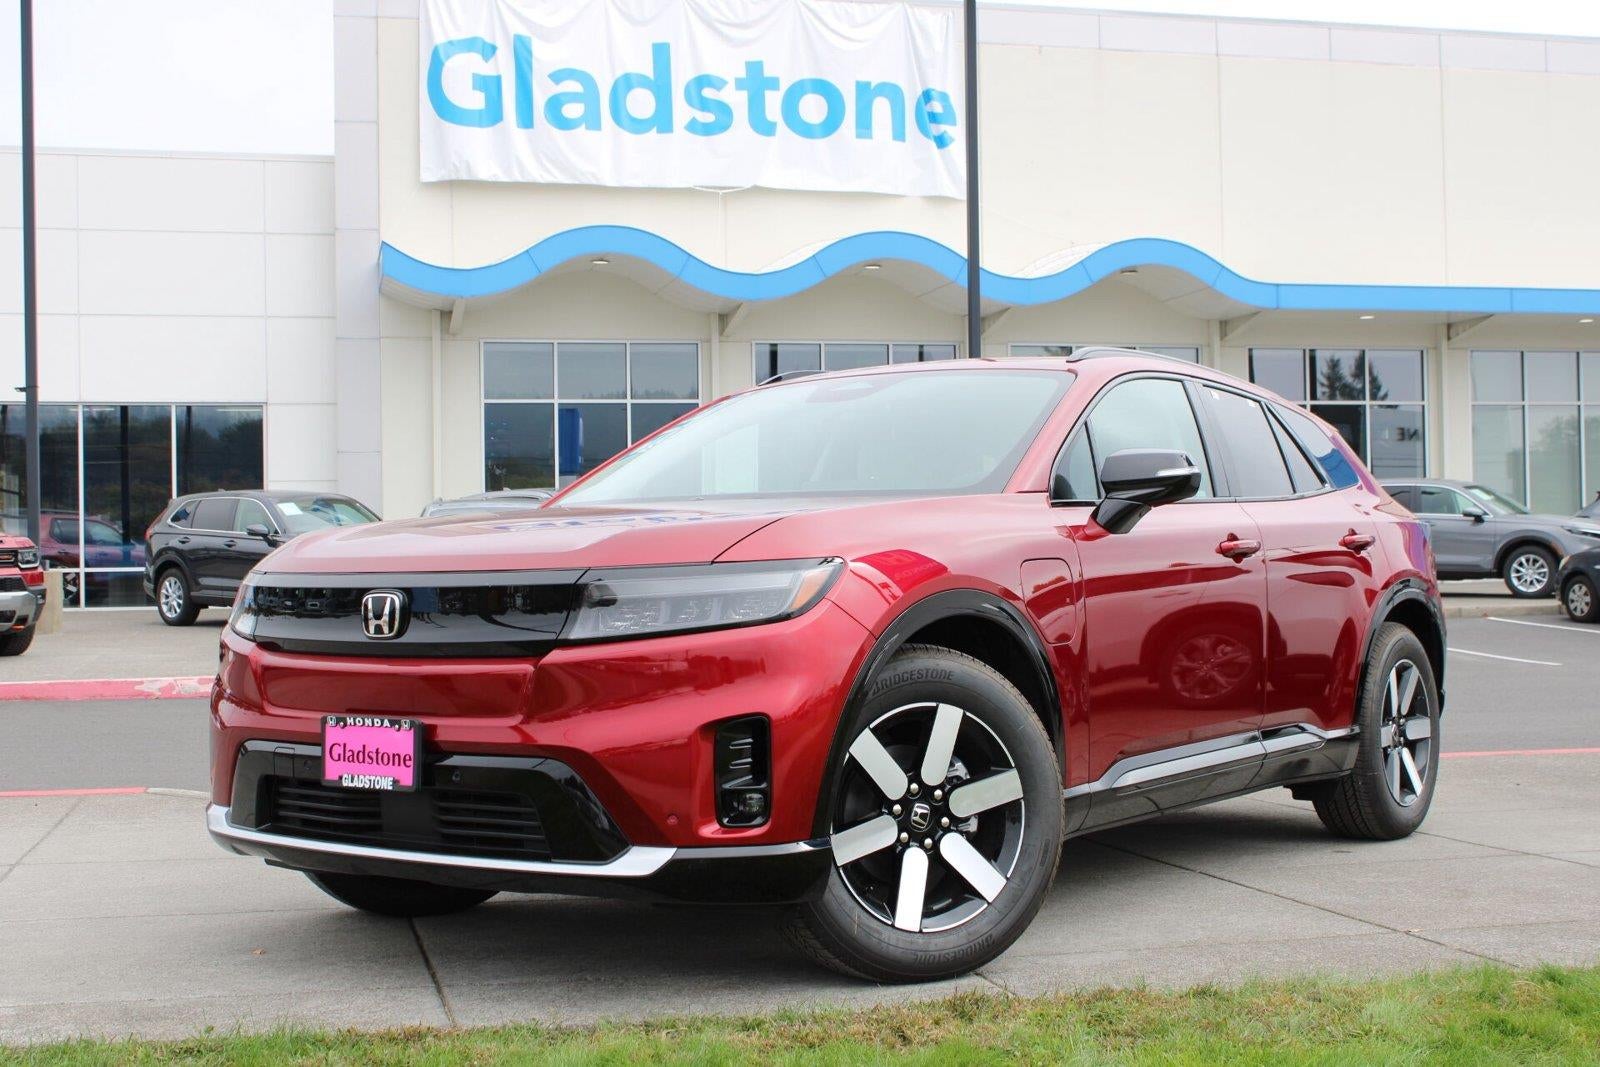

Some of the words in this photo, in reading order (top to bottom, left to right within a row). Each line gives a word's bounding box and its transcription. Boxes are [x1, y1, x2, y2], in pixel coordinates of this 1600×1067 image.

[427, 34, 957, 149] Gladstone
[872, 668, 955, 695] BRIDGESTONE
[346, 717, 391, 728] HONDA
[329, 743, 412, 768] Gladstone
[342, 774, 394, 790] GLADSTONE
